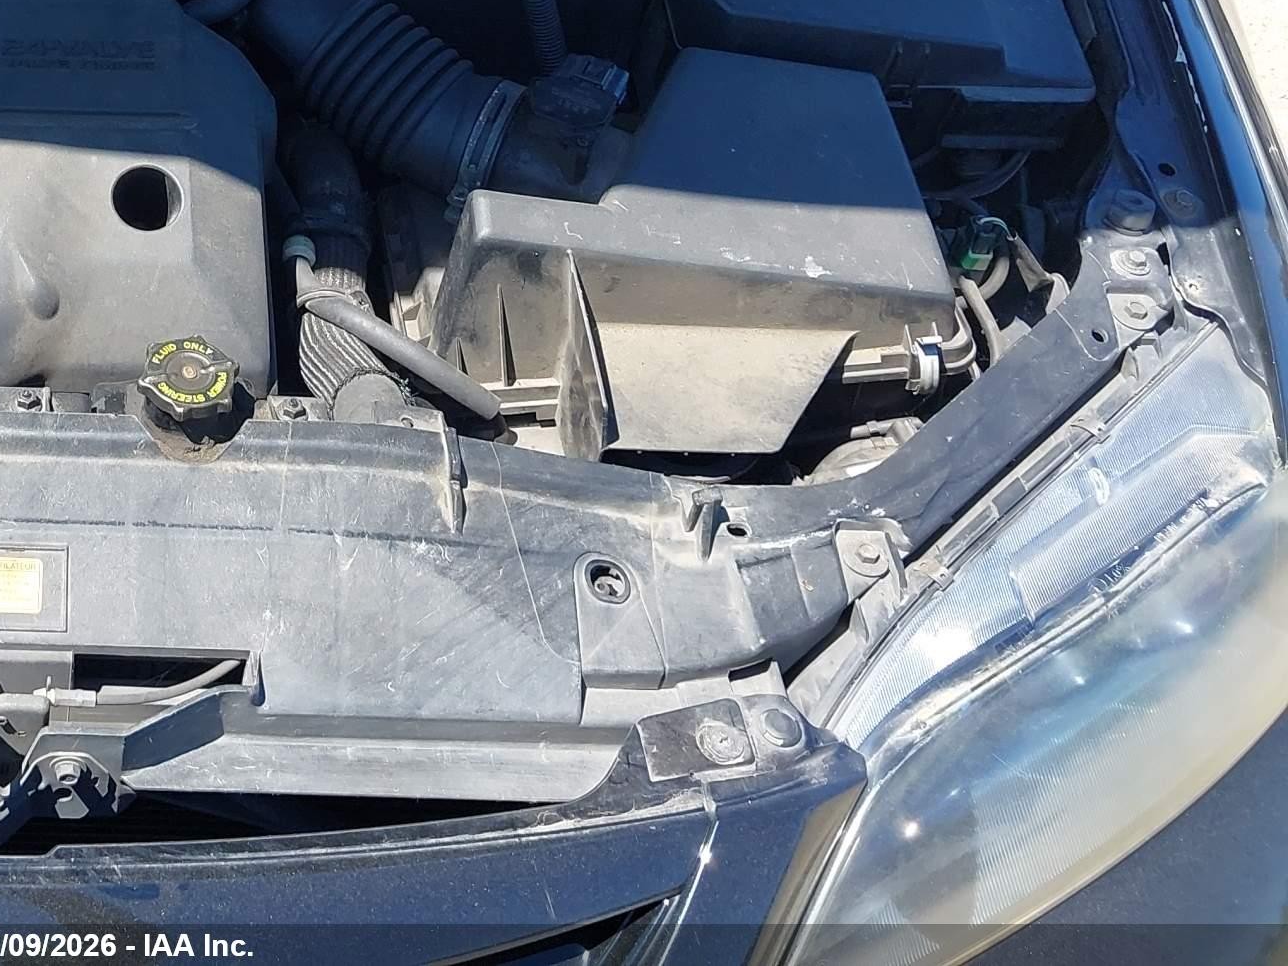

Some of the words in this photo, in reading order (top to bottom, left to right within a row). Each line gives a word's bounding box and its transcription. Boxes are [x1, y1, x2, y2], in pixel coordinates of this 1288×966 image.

[152, 343, 177, 364] FLUID
[183, 341, 214, 355] ONLY
[157, 382, 206, 403] STEERING
[206, 371, 228, 398] POWER
